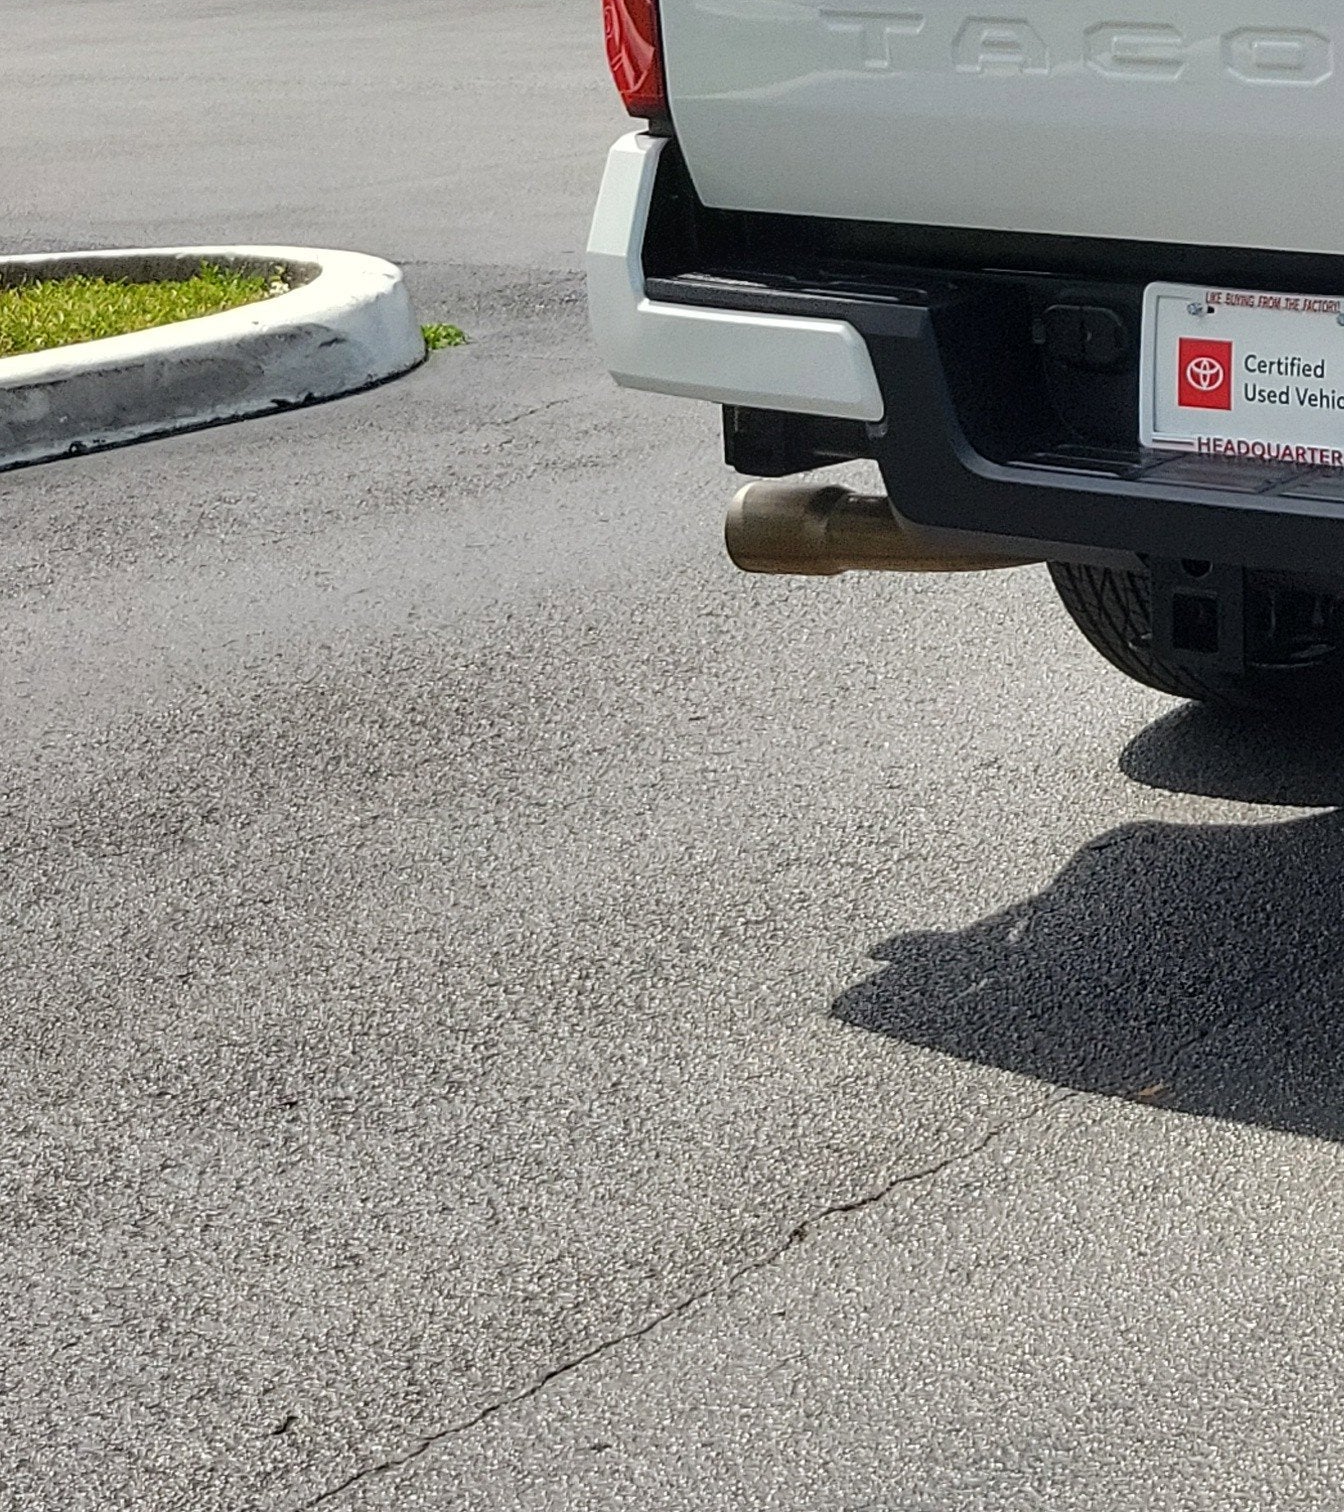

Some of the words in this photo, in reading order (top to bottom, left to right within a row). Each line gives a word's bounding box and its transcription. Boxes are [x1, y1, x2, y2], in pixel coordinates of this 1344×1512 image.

[1206, 291, 1222, 305] LIKE
[1225, 292, 1255, 308] BUYING
[1257, 294, 1282, 310] FROM
[1284, 297, 1300, 311] THE
[1244, 354, 1326, 379] Certified
[1244, 382, 1290, 405] Used
[1197, 436, 1344, 467] HEADQUARTER
